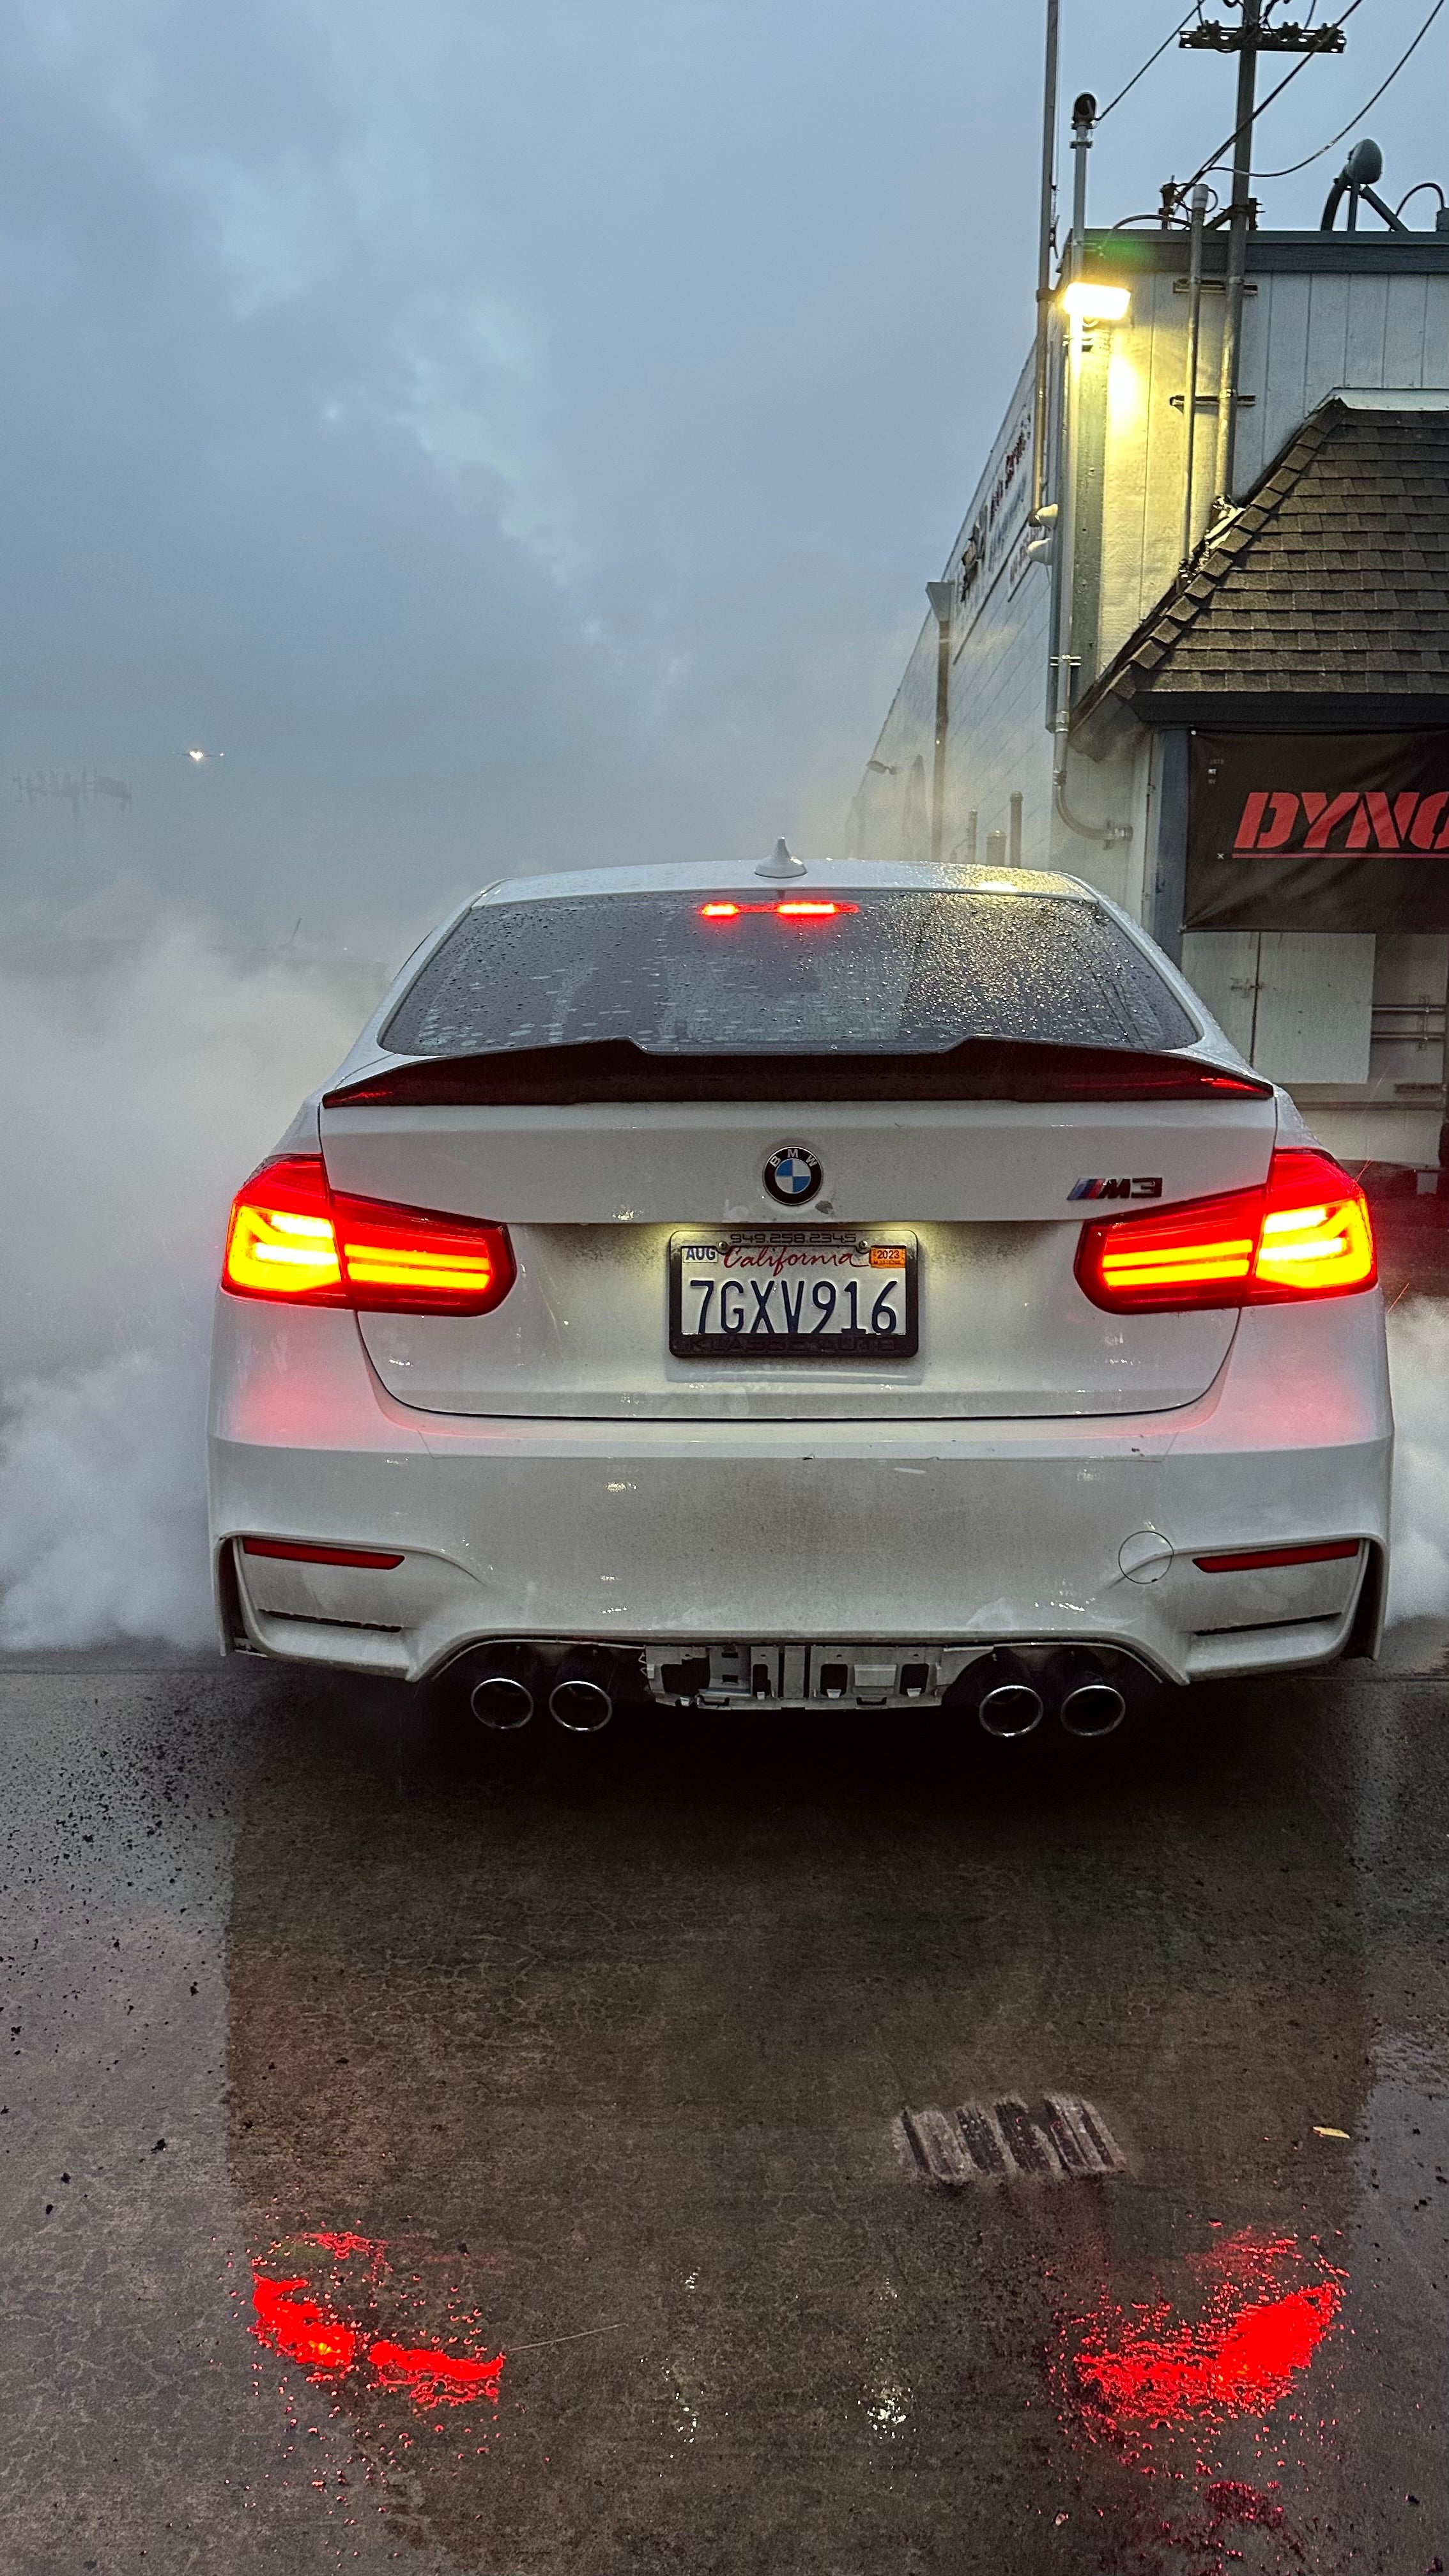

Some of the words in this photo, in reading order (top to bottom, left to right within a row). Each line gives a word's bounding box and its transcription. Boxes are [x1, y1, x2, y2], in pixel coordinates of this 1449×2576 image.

[769, 1148, 818, 1167] BMW
[1096, 1177, 1163, 1199] M3
[730, 1233, 857, 1244] 949.258.2345
[686, 1246, 716, 1261] AUG
[723, 1246, 870, 1276] California
[877, 1250, 900, 1259] 2023
[690, 1280, 898, 1334] 7GXV916
